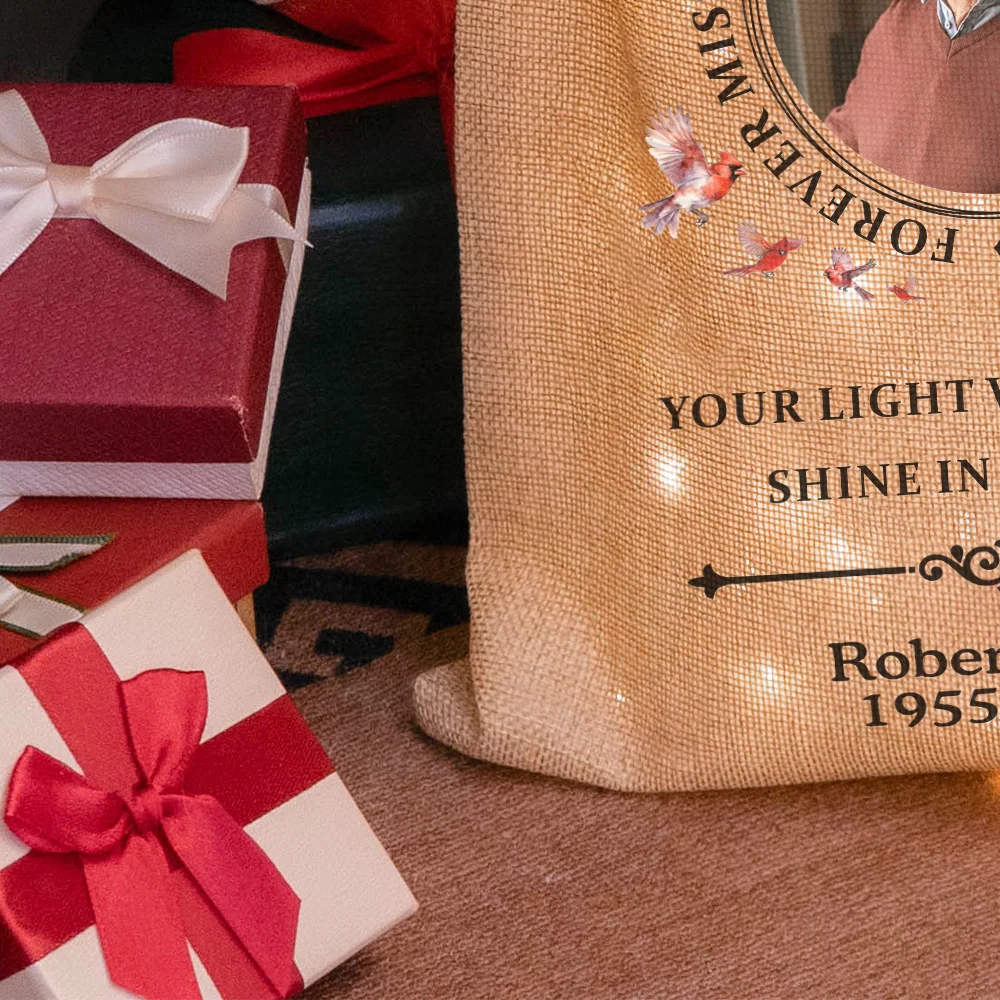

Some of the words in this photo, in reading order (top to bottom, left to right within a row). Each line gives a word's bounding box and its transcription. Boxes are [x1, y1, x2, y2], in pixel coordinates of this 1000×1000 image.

[739, 107, 960, 265] FOREVER
[660, 385, 805, 430] YOUR
[818, 378, 974, 424] LIGHT
[768, 461, 922, 505] SHINE
[936, 457, 990, 494] IN
[863, 687, 1000, 729] 1955
